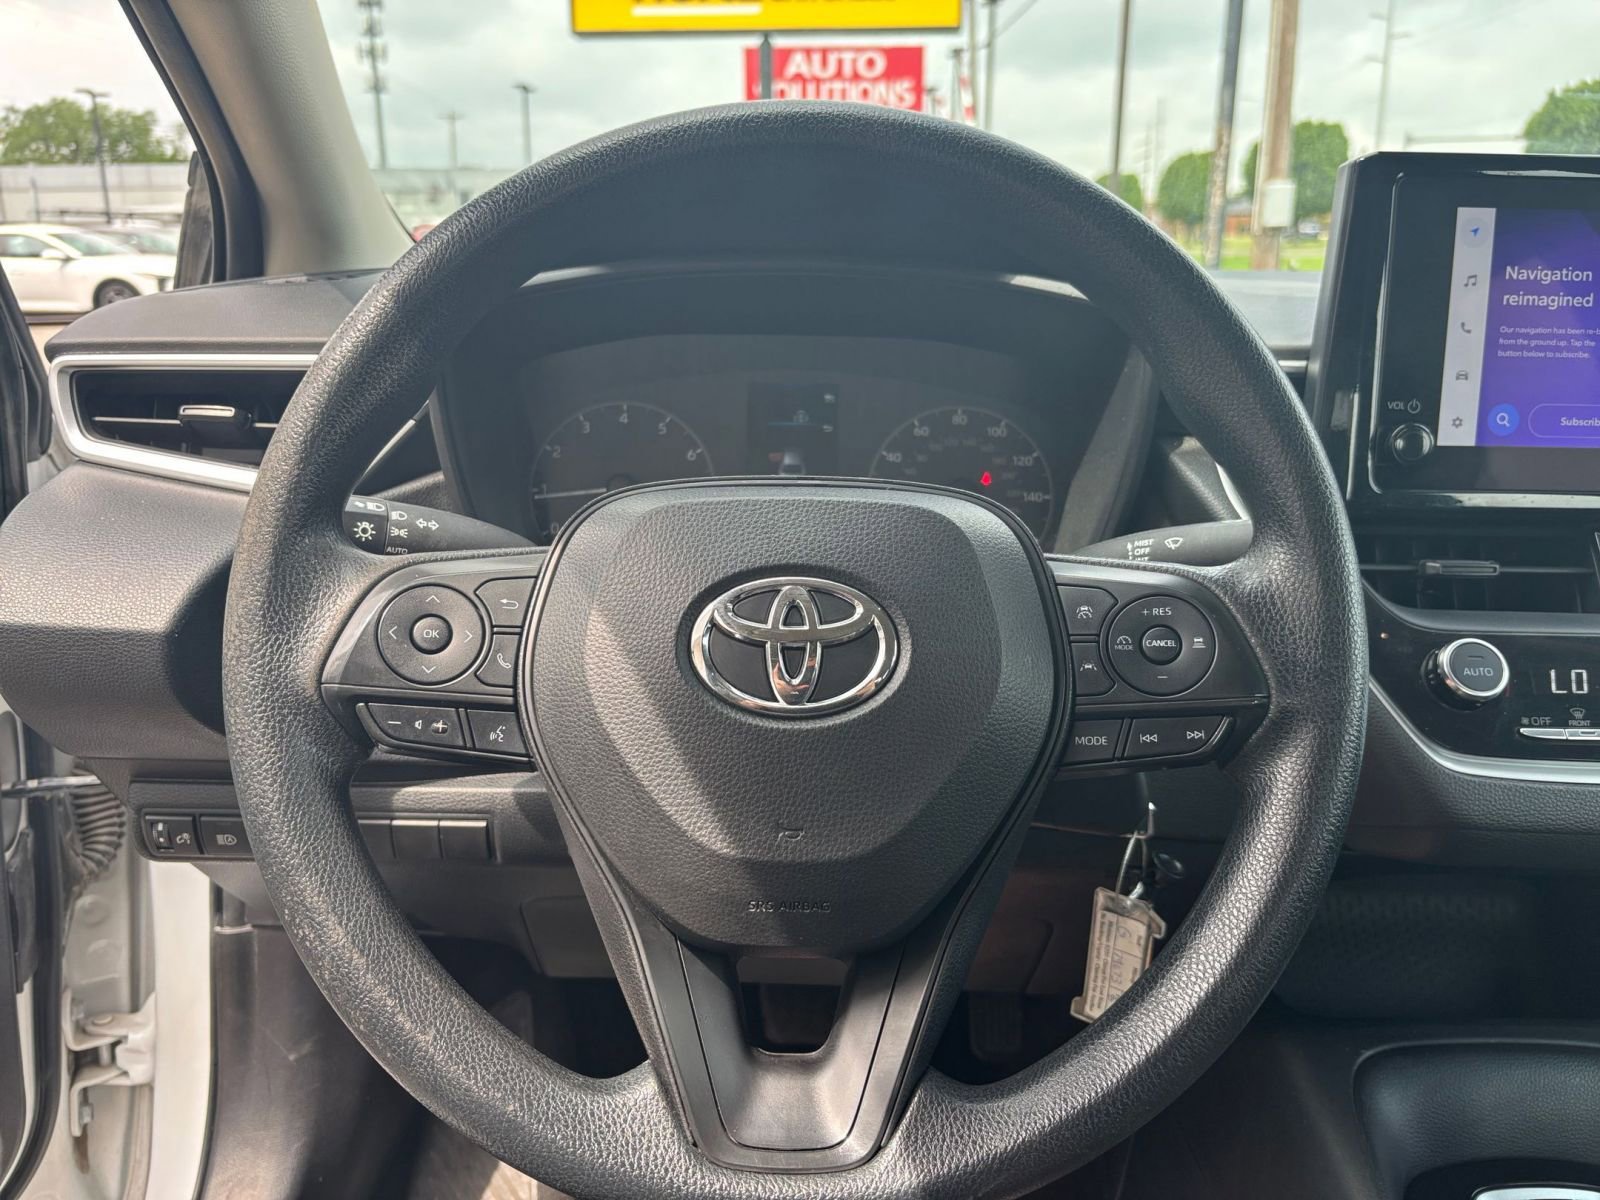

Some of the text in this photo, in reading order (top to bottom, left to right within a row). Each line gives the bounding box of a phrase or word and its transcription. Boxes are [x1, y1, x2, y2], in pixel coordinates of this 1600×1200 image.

[783, 50, 887, 79] AUTO
[1505, 265, 1593, 284] Navigation
[1503, 291, 1594, 310] reimagined
[1500, 326, 1514, 334] Our
[1515, 326, 1553, 336] navigation
[1553, 327, 1566, 335] has
[1567, 327, 1585, 335] been
[1516, 338, 1529, 346] the
[1529, 338, 1557, 347] ground
[1583, 339, 1597, 347] the
[1522, 350, 1545, 358] below
[1546, 350, 1554, 358] to
[1387, 401, 1405, 410] VOL
[618, 413, 629, 425] 4
[952, 415, 968, 426] 80
[582, 422, 591, 434] 3
[657, 423, 668, 435] 5
[913, 426, 930, 438] 60
[987, 426, 1007, 438] 100
[552, 446, 561, 458] 2
[687, 450, 697, 461] 6
[886, 452, 902, 464] 40
[1013, 455, 1033, 467] 120
[1023, 491, 1043, 503] 140
[1134, 538, 1154, 547] MIST
[386, 546, 408, 555] AUTO
[1134, 547, 1150, 556] OFF
[423, 629, 440, 639] OK
[1146, 639, 1177, 648] CANCEL
[1463, 667, 1494, 677] AUTO
[1550, 669, 1589, 694] LO
[1531, 717, 1552, 726] OFF
[1568, 719, 1591, 727] FRONT
[1075, 736, 1108, 746] MODE
[748, 901, 831, 913] SRS AIRBAG
